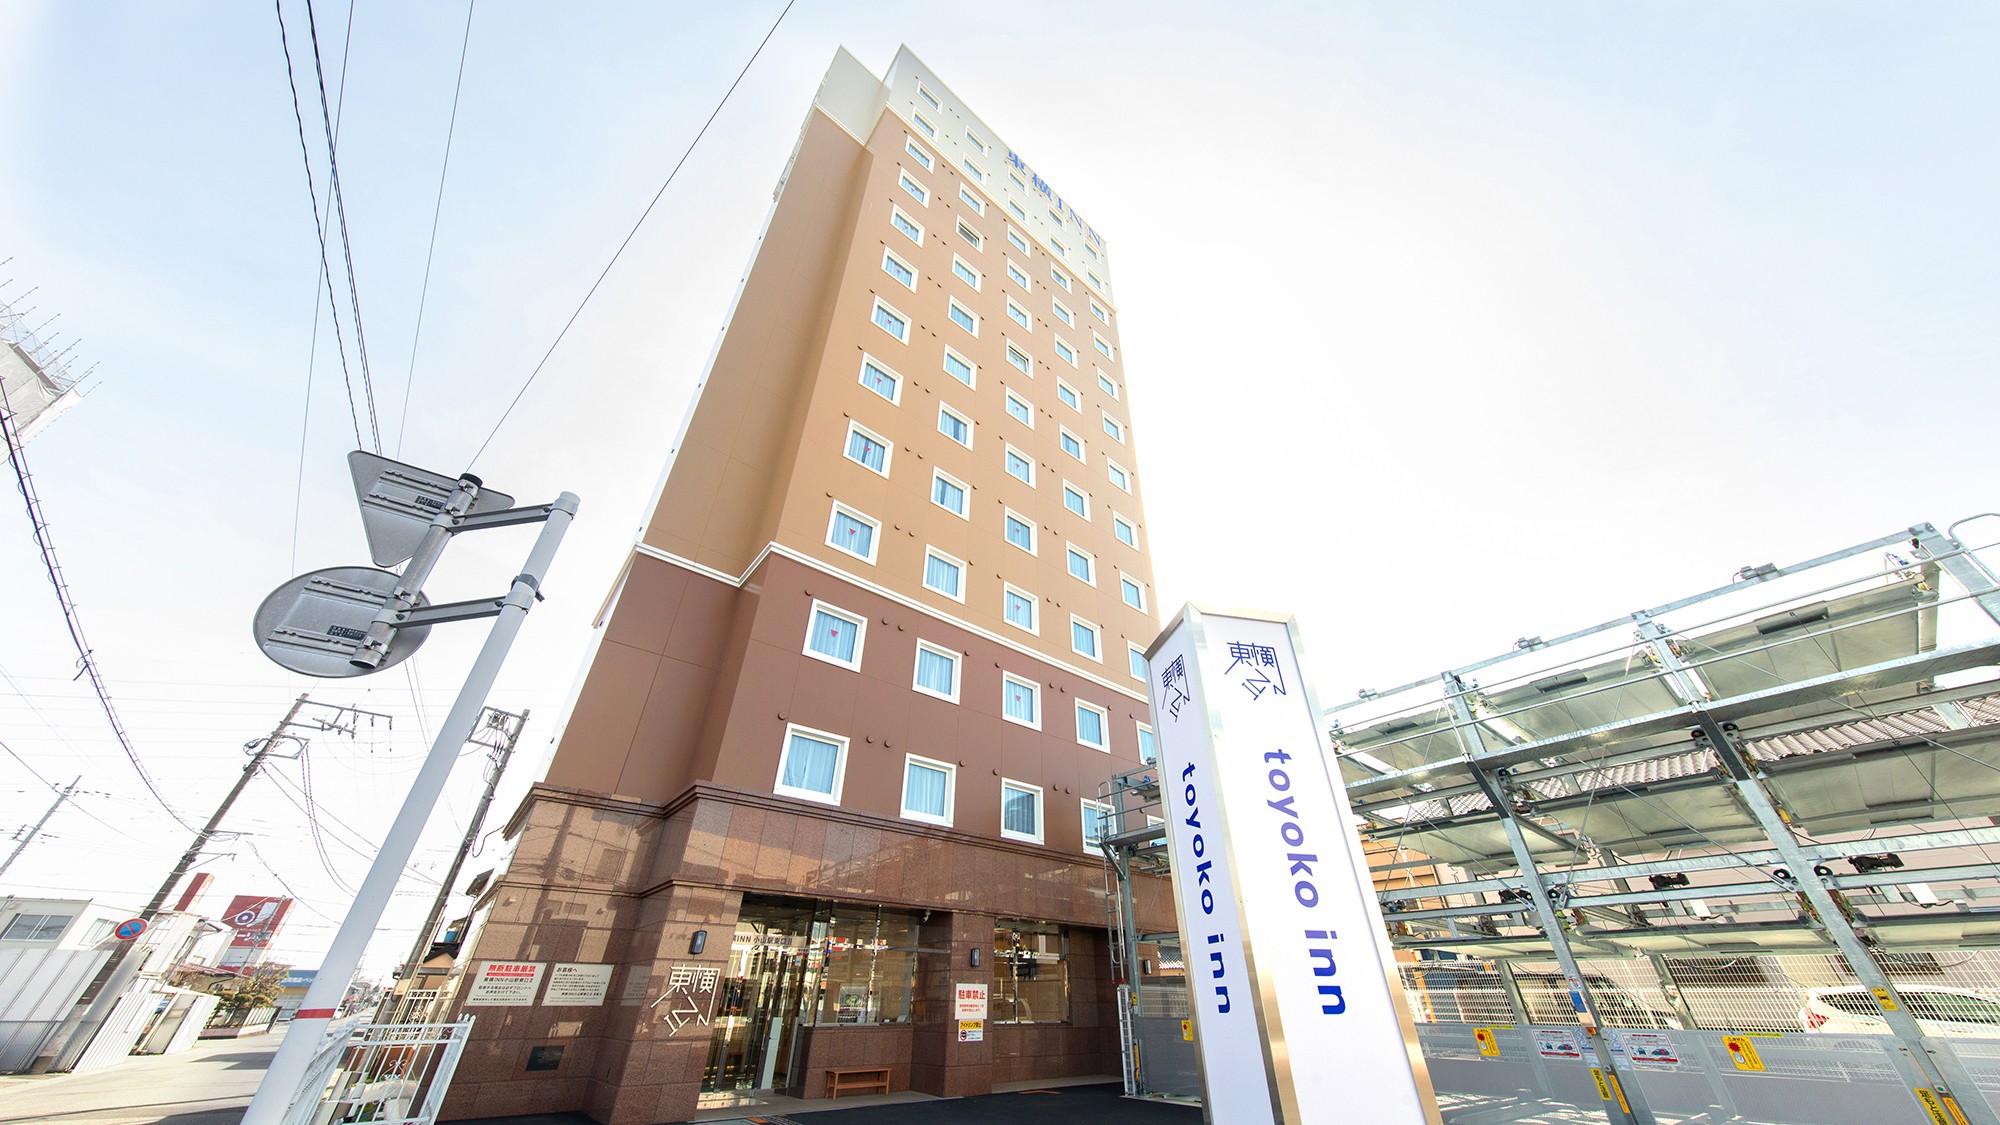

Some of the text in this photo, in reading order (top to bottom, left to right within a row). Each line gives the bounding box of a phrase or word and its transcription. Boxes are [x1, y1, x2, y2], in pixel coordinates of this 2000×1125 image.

[958, 990, 986, 1000] 駐車禁止
[1181, 762, 1232, 1015] toyoko inn
[1263, 748, 1347, 1016] toyoko inn
